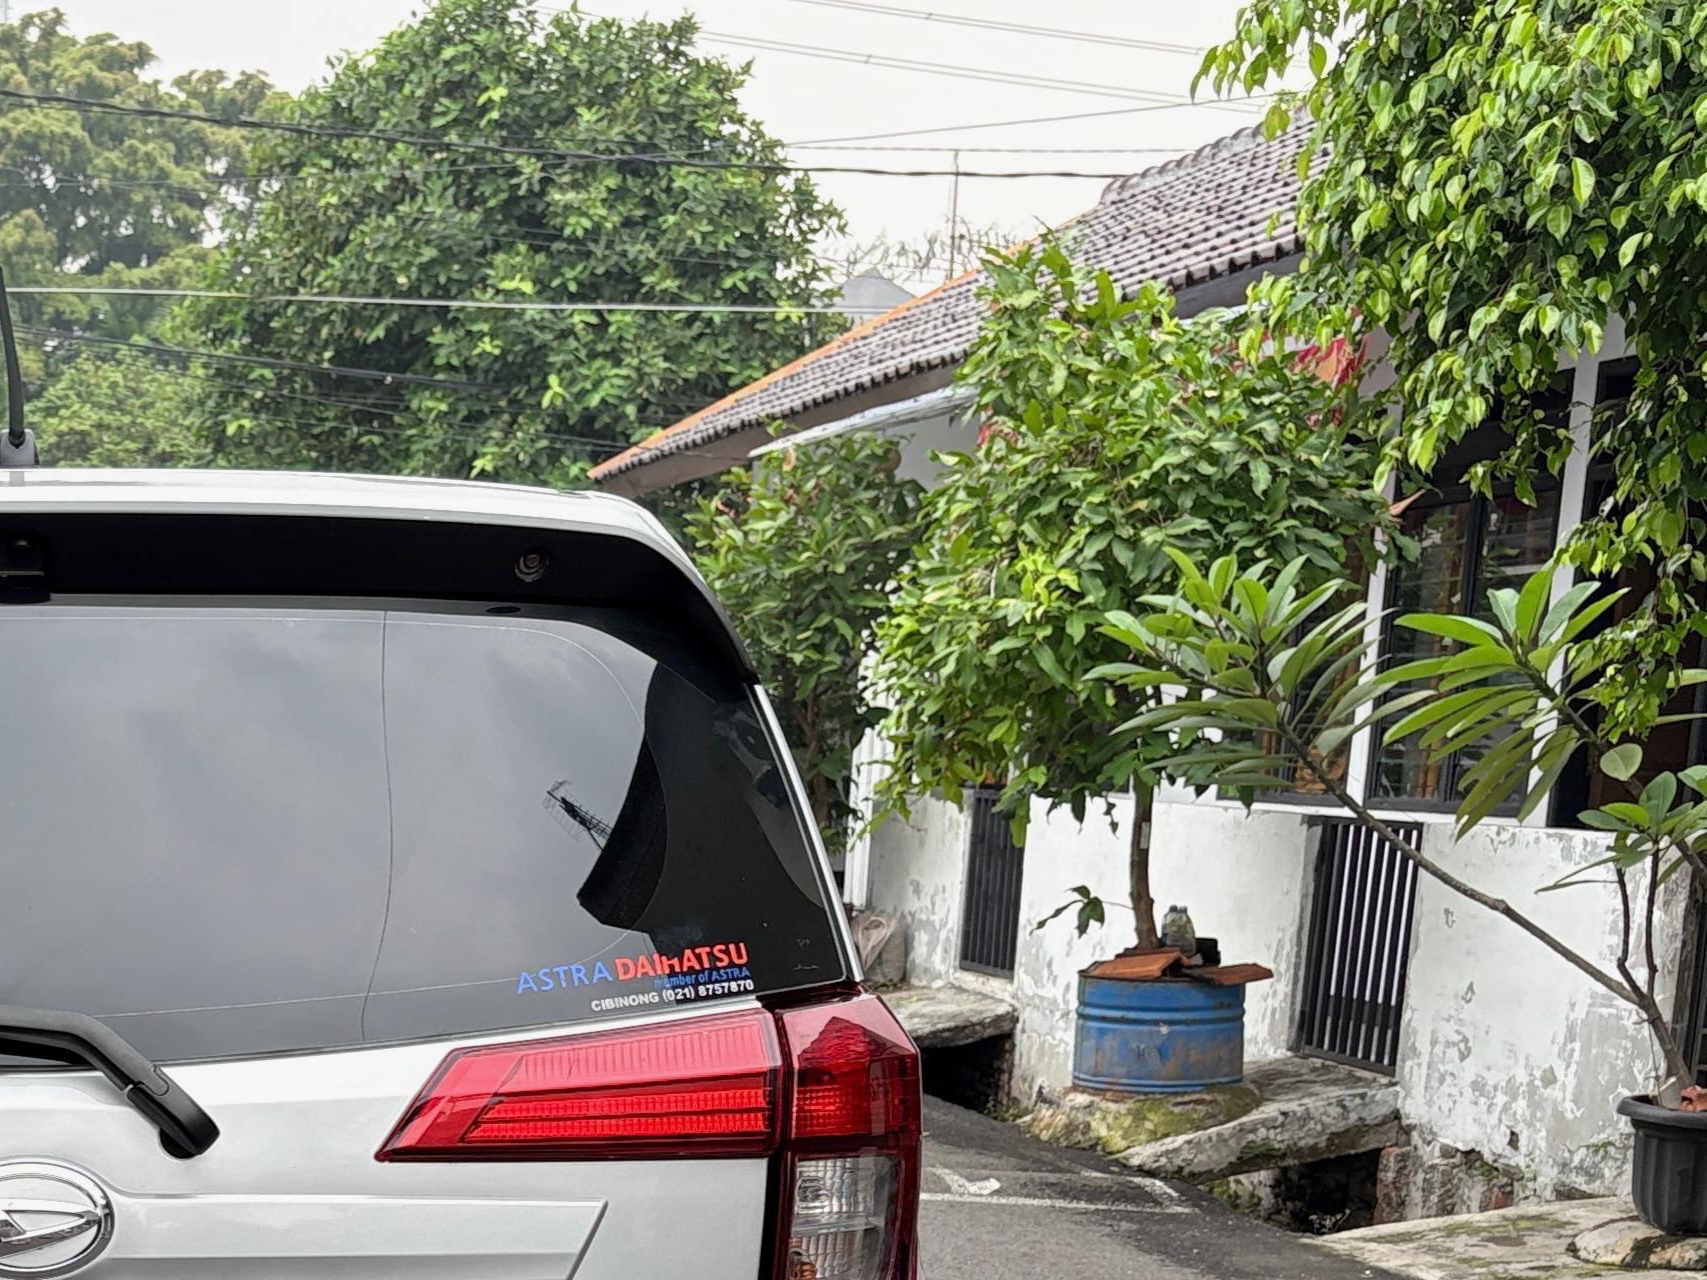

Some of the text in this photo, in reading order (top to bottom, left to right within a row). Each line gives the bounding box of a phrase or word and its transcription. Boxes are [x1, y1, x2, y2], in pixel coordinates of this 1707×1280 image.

[516, 961, 613, 994] ASTRA
[654, 966, 751, 989] member of ASTRA
[591, 979, 755, 1012] CIBINONG (021) 8757870
